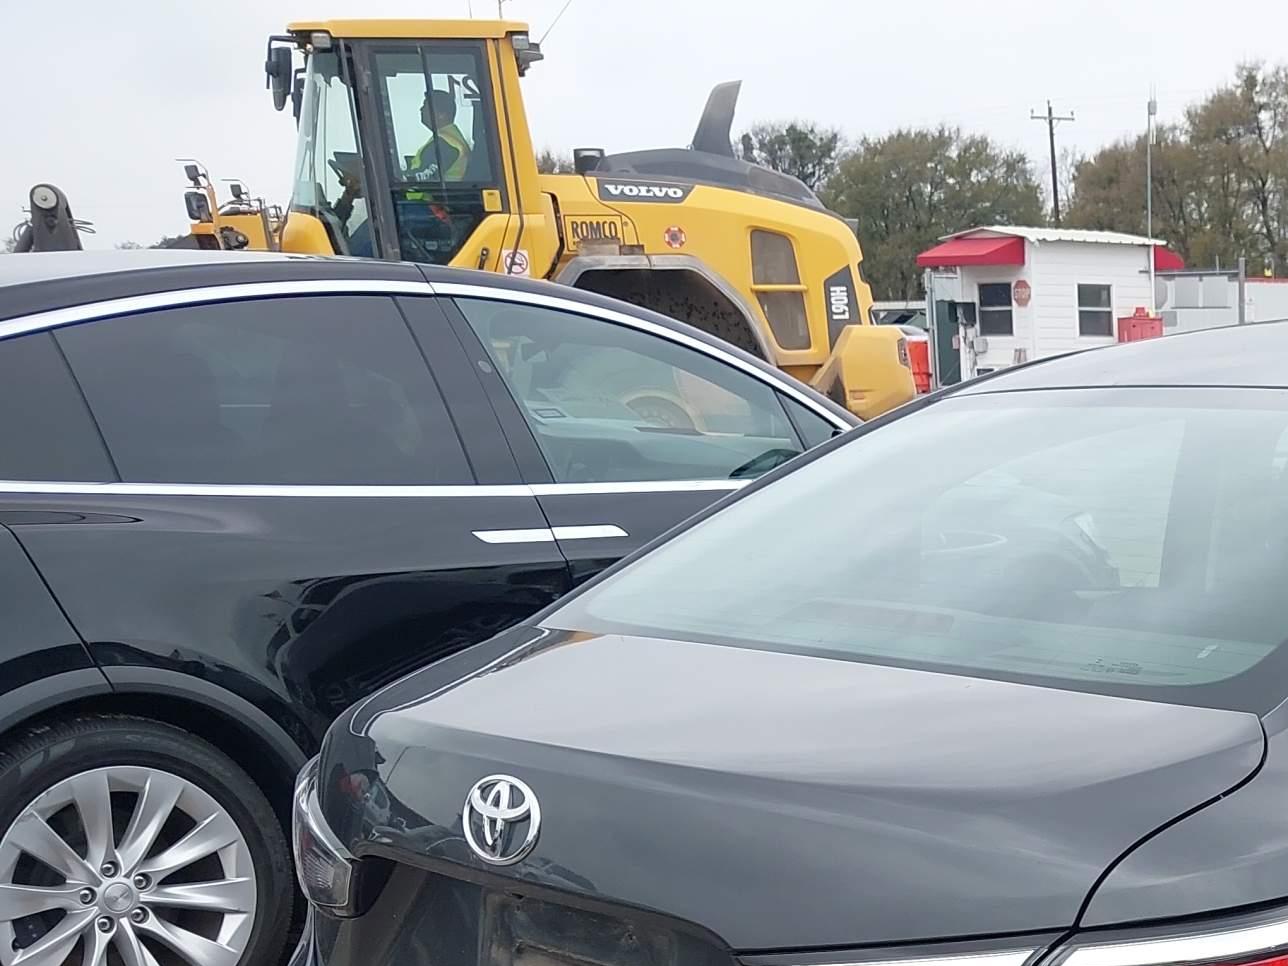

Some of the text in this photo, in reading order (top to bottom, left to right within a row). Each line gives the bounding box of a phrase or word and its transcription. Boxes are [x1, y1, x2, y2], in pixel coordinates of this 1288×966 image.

[604, 184, 684, 198] VOLVO
[571, 220, 618, 240] ROMCO
[830, 286, 850, 320] L90H
